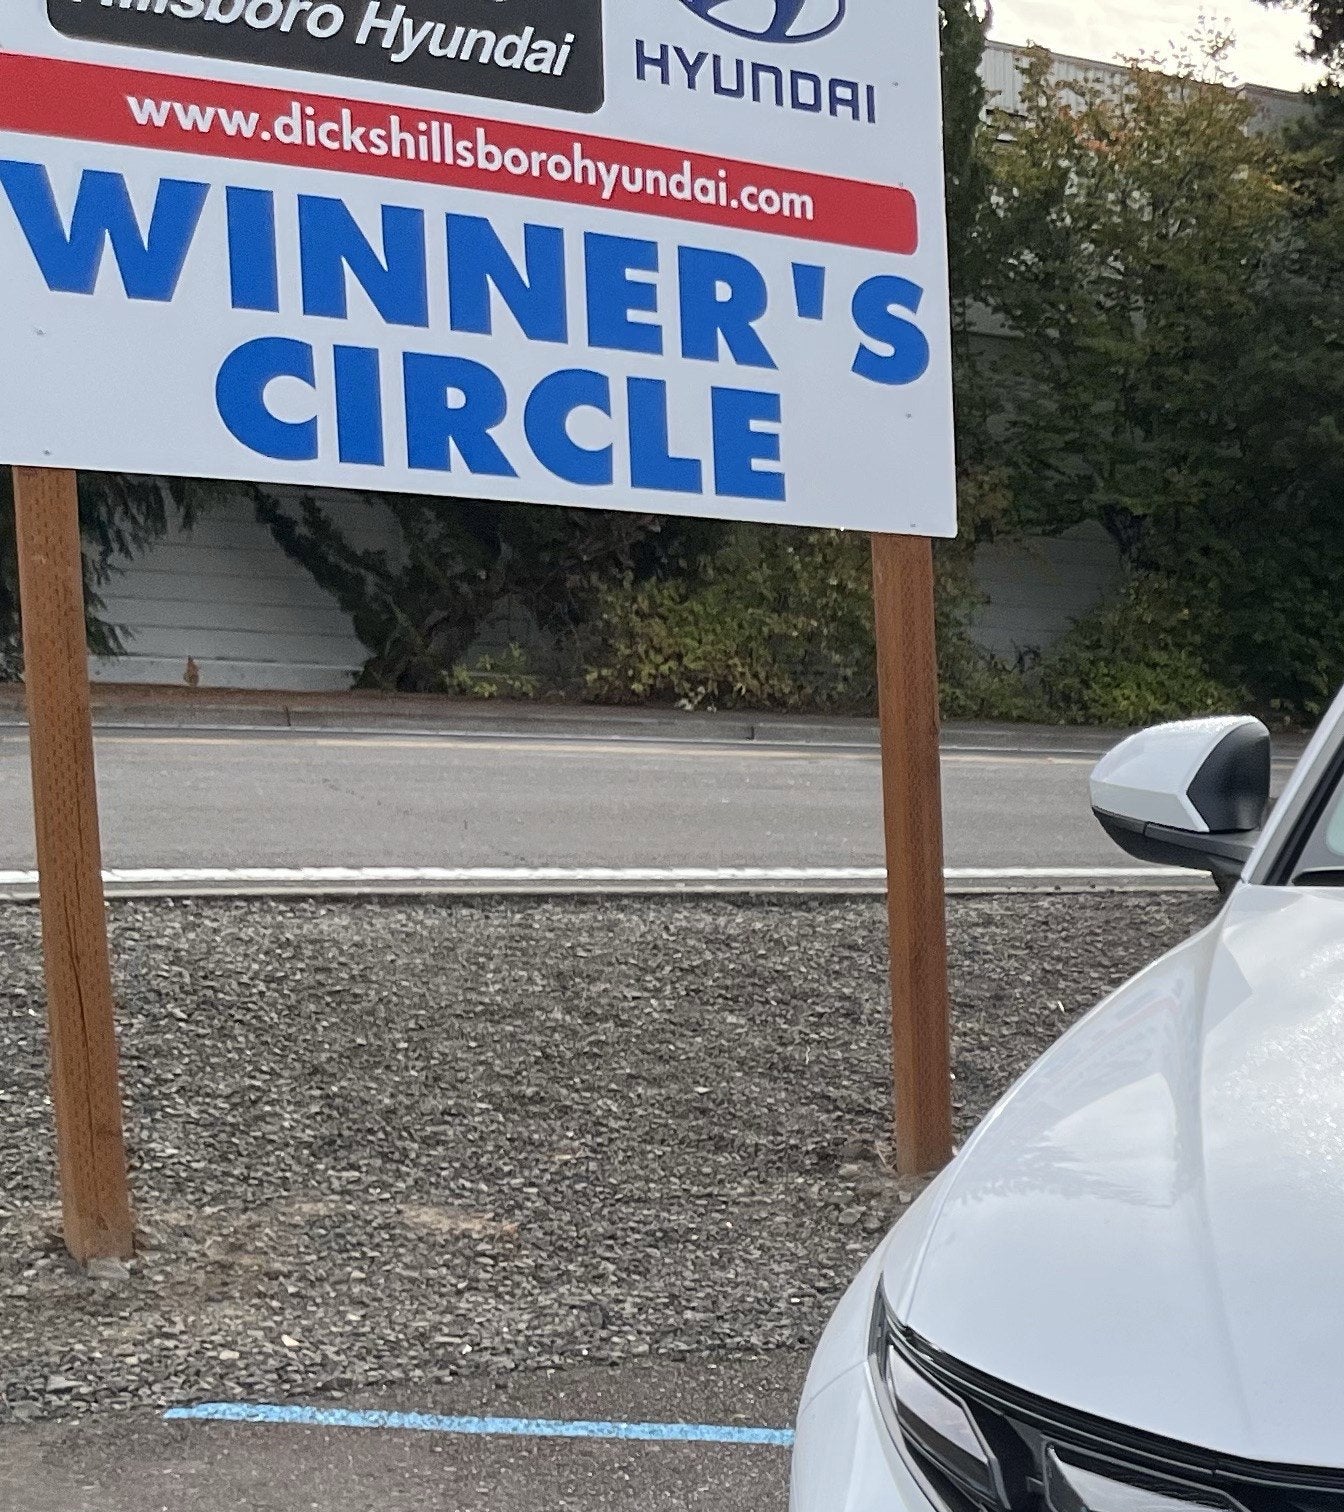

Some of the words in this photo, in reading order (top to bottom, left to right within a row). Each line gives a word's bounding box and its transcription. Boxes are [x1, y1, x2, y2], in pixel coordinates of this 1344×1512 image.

[355, 0, 576, 77] Hyundai
[634, 39, 876, 124] HYUNDAI
[126, 91, 815, 222] www.dickshillsborohyundai.com
[0, 159, 931, 386] WINNER'S
[215, 337, 787, 502] CIRCLE
